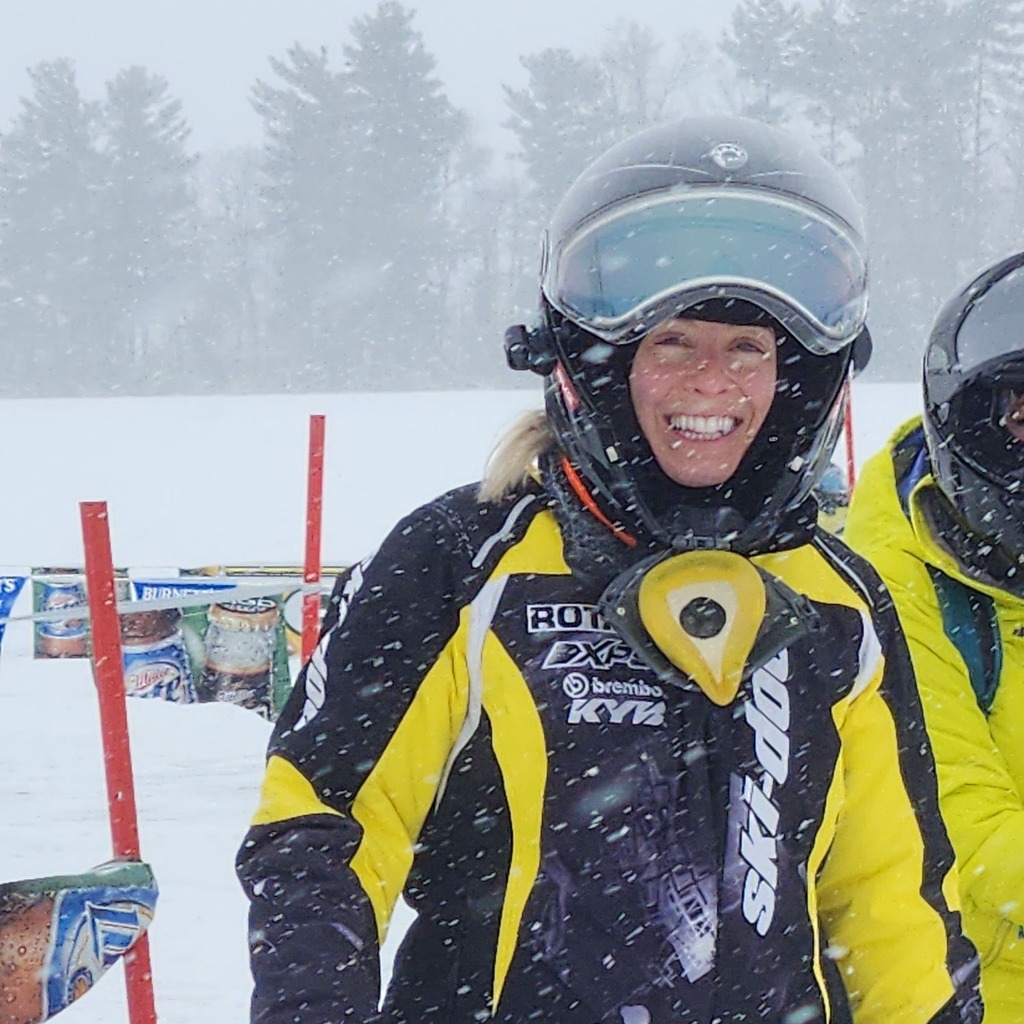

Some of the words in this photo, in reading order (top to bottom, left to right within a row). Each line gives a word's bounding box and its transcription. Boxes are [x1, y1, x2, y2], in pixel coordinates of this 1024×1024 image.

[530, 605, 613, 631] ROT
[591, 676, 663, 697] brembo
[567, 698, 667, 725] KYB
